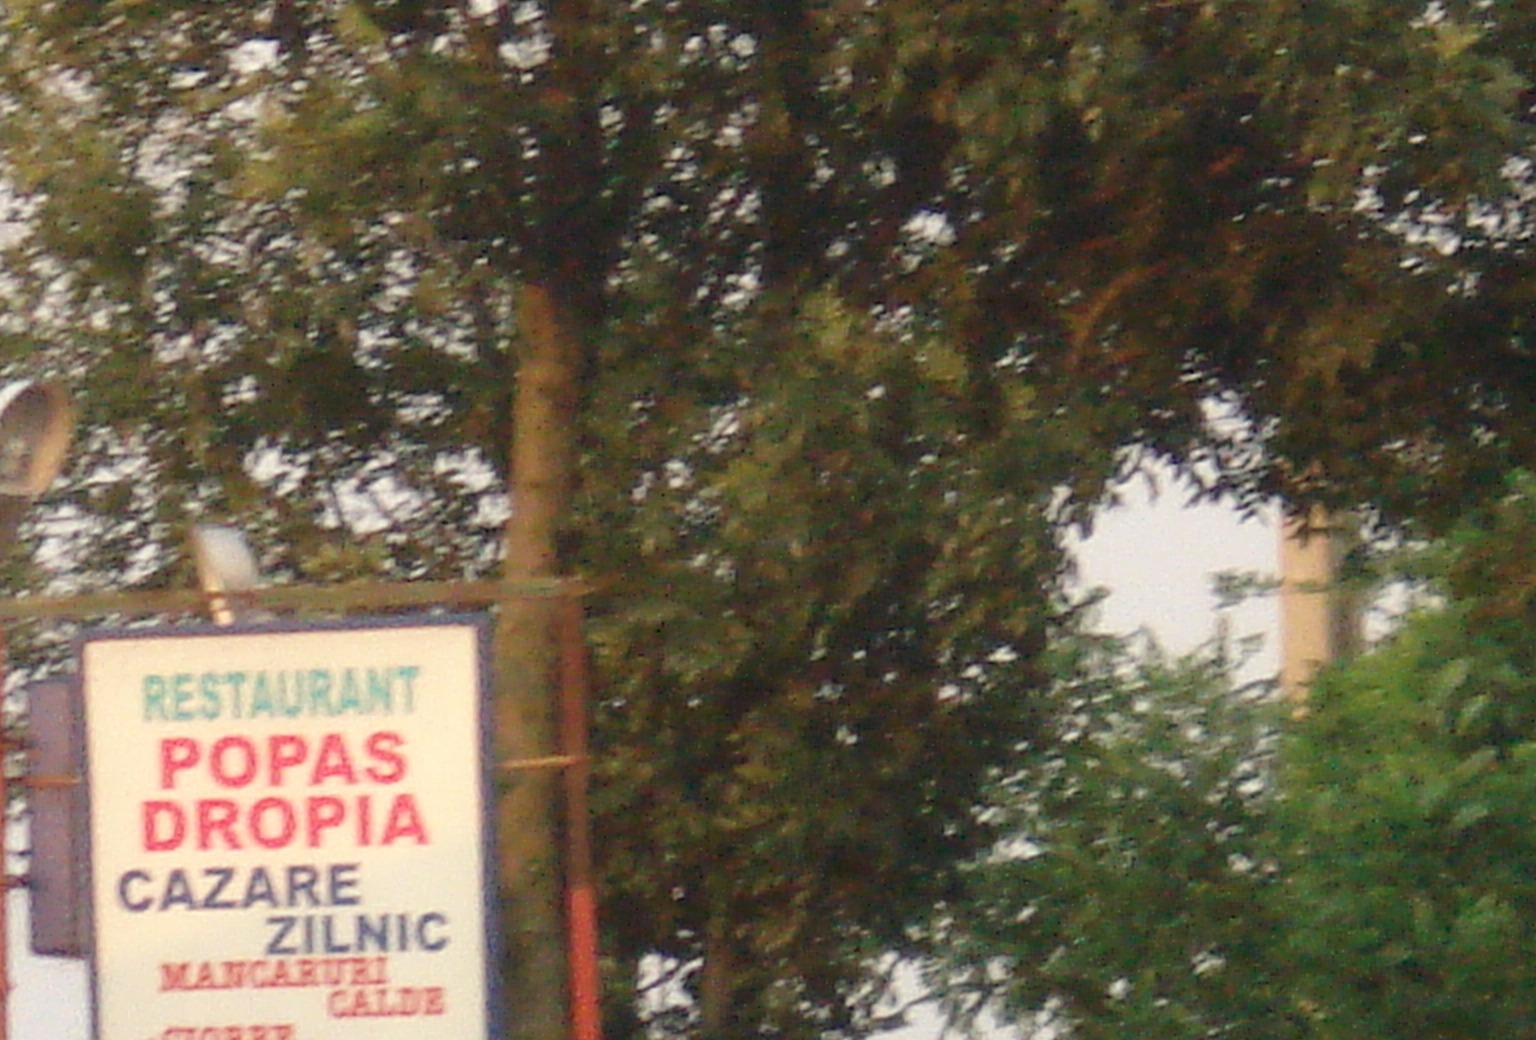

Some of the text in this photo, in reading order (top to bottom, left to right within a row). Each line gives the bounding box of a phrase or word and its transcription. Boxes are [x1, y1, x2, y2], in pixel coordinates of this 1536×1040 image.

[142, 667, 420, 721] RESTAURANT
[159, 731, 406, 789] POPAS
[142, 794, 429, 851] DROPIA
[118, 863, 361, 911] CAZARE
[265, 912, 449, 955] ZILNIC
[327, 987, 446, 1018] CALDE
